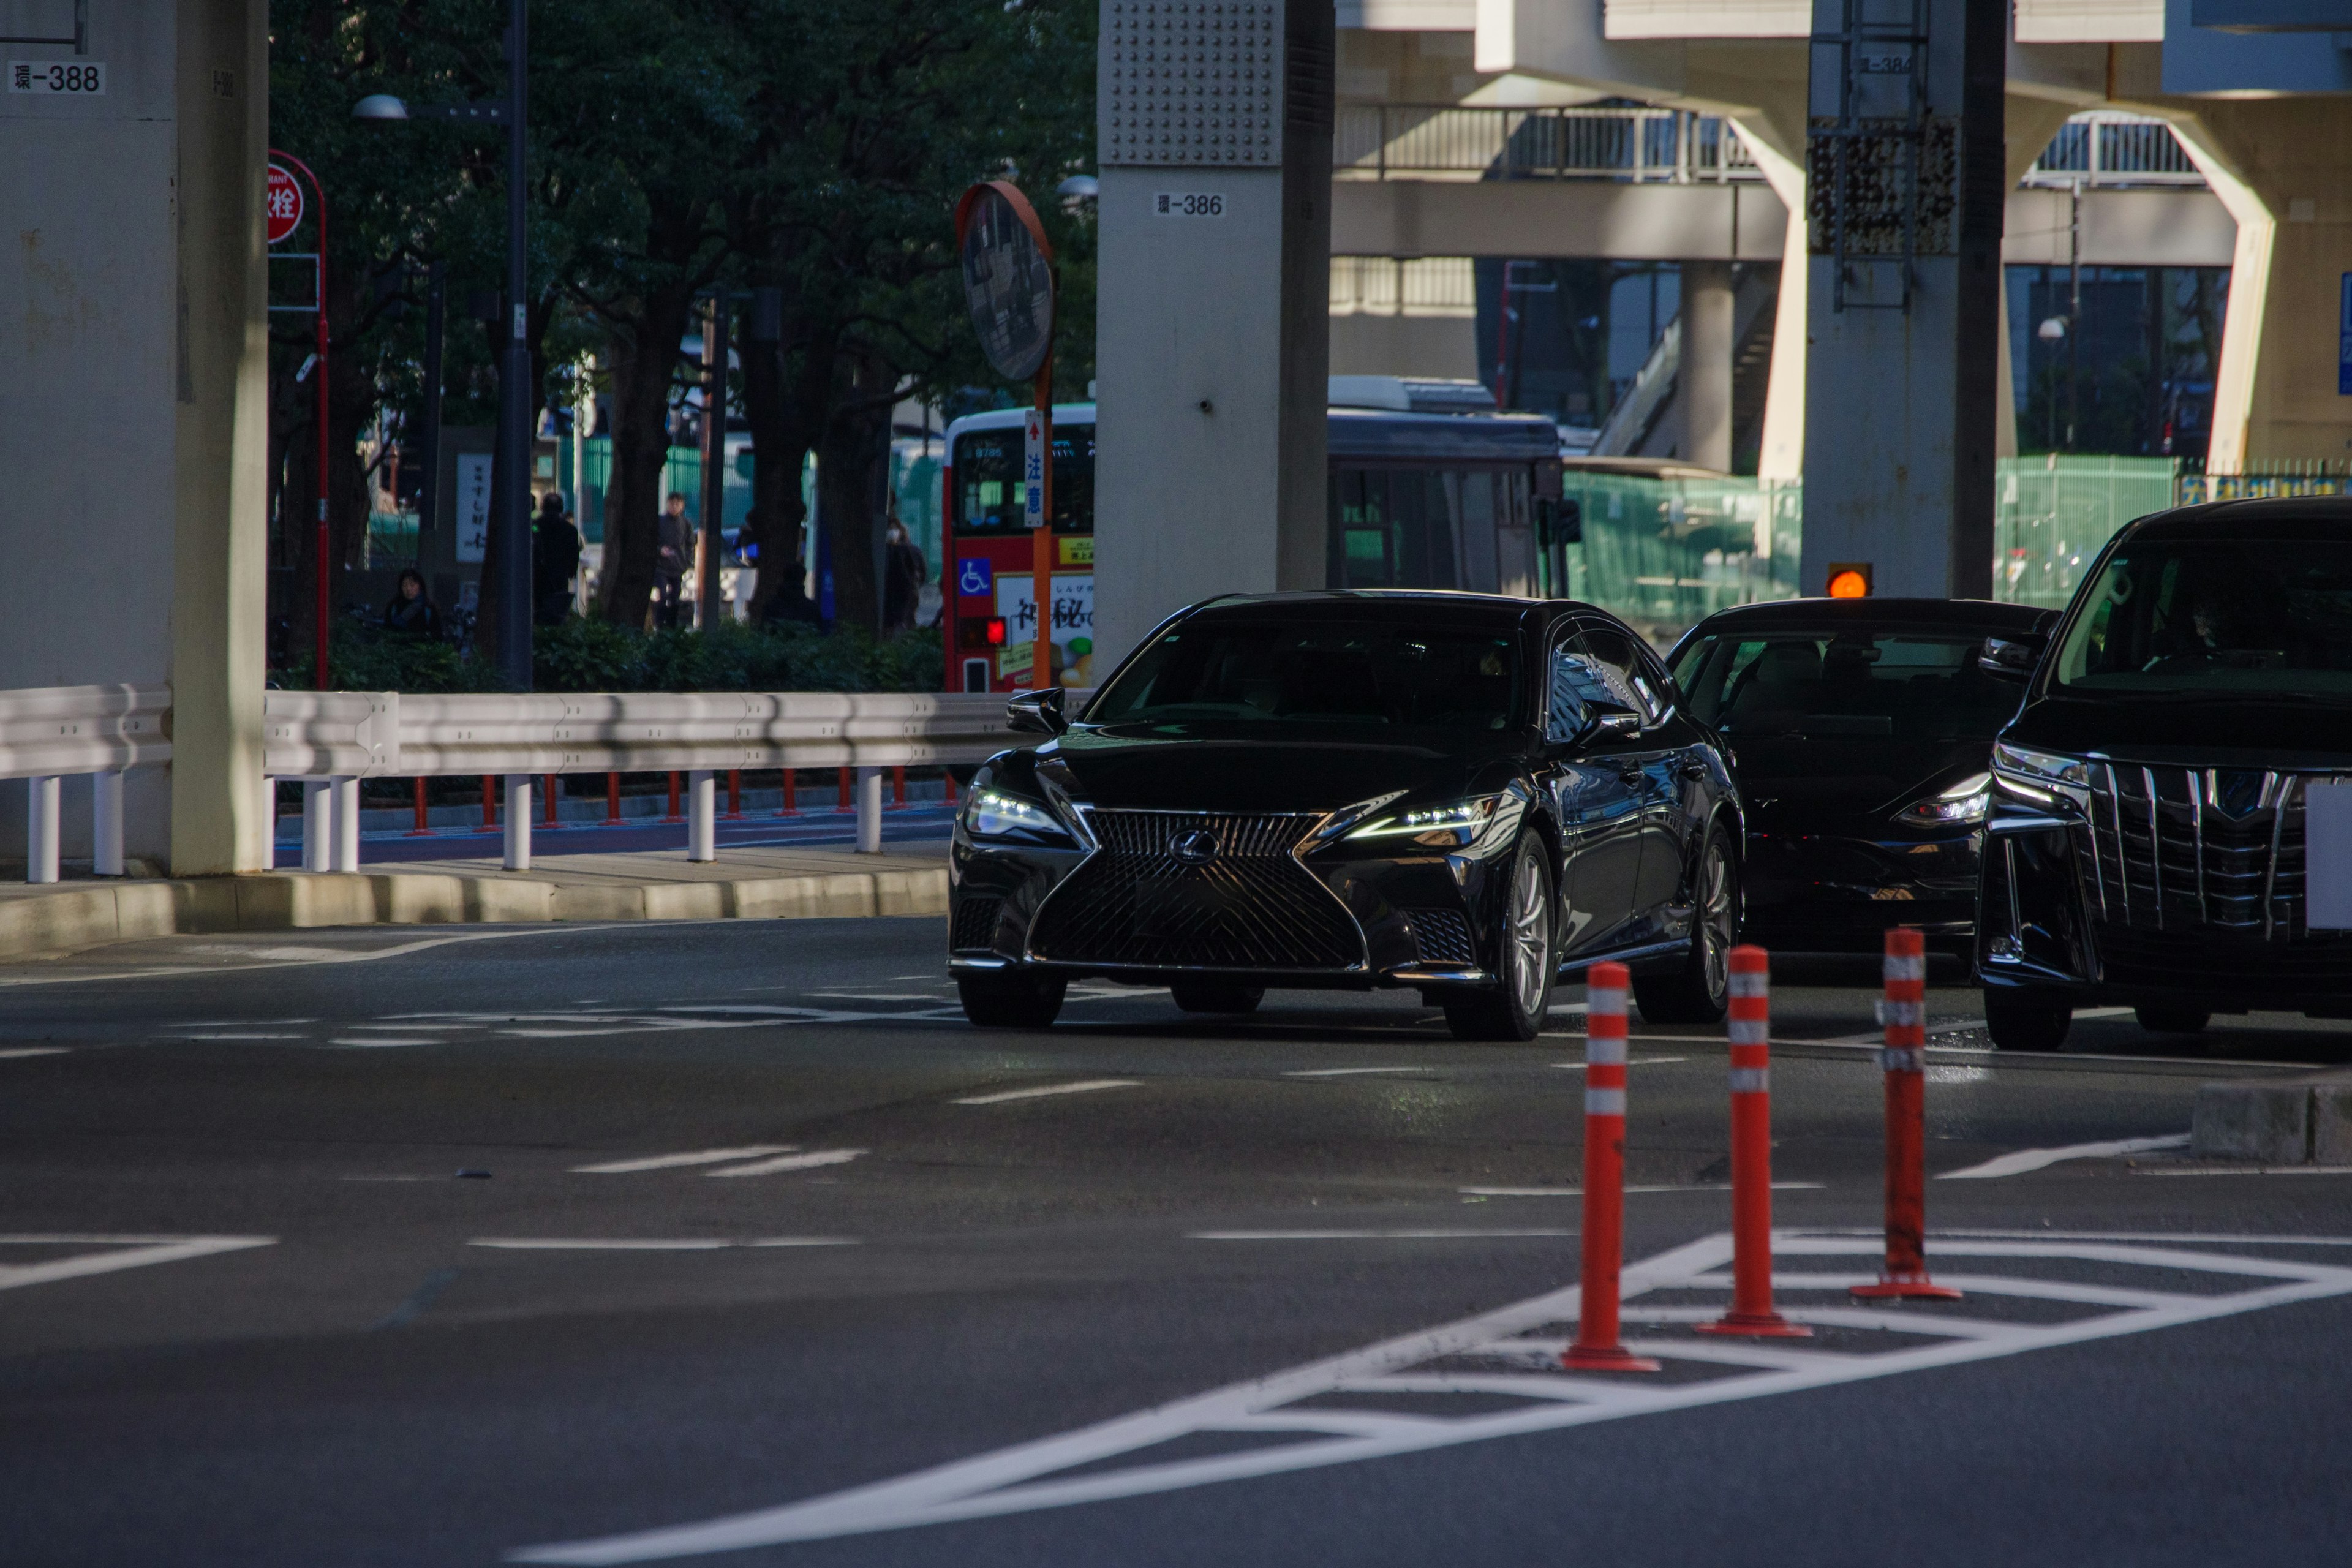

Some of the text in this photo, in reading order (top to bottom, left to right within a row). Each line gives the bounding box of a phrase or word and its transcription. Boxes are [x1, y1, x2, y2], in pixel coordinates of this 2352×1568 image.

[15, 65, 99, 91] 環-388
[1158, 195, 1222, 214] 環-386
[1028, 454, 1040, 514] 注意
